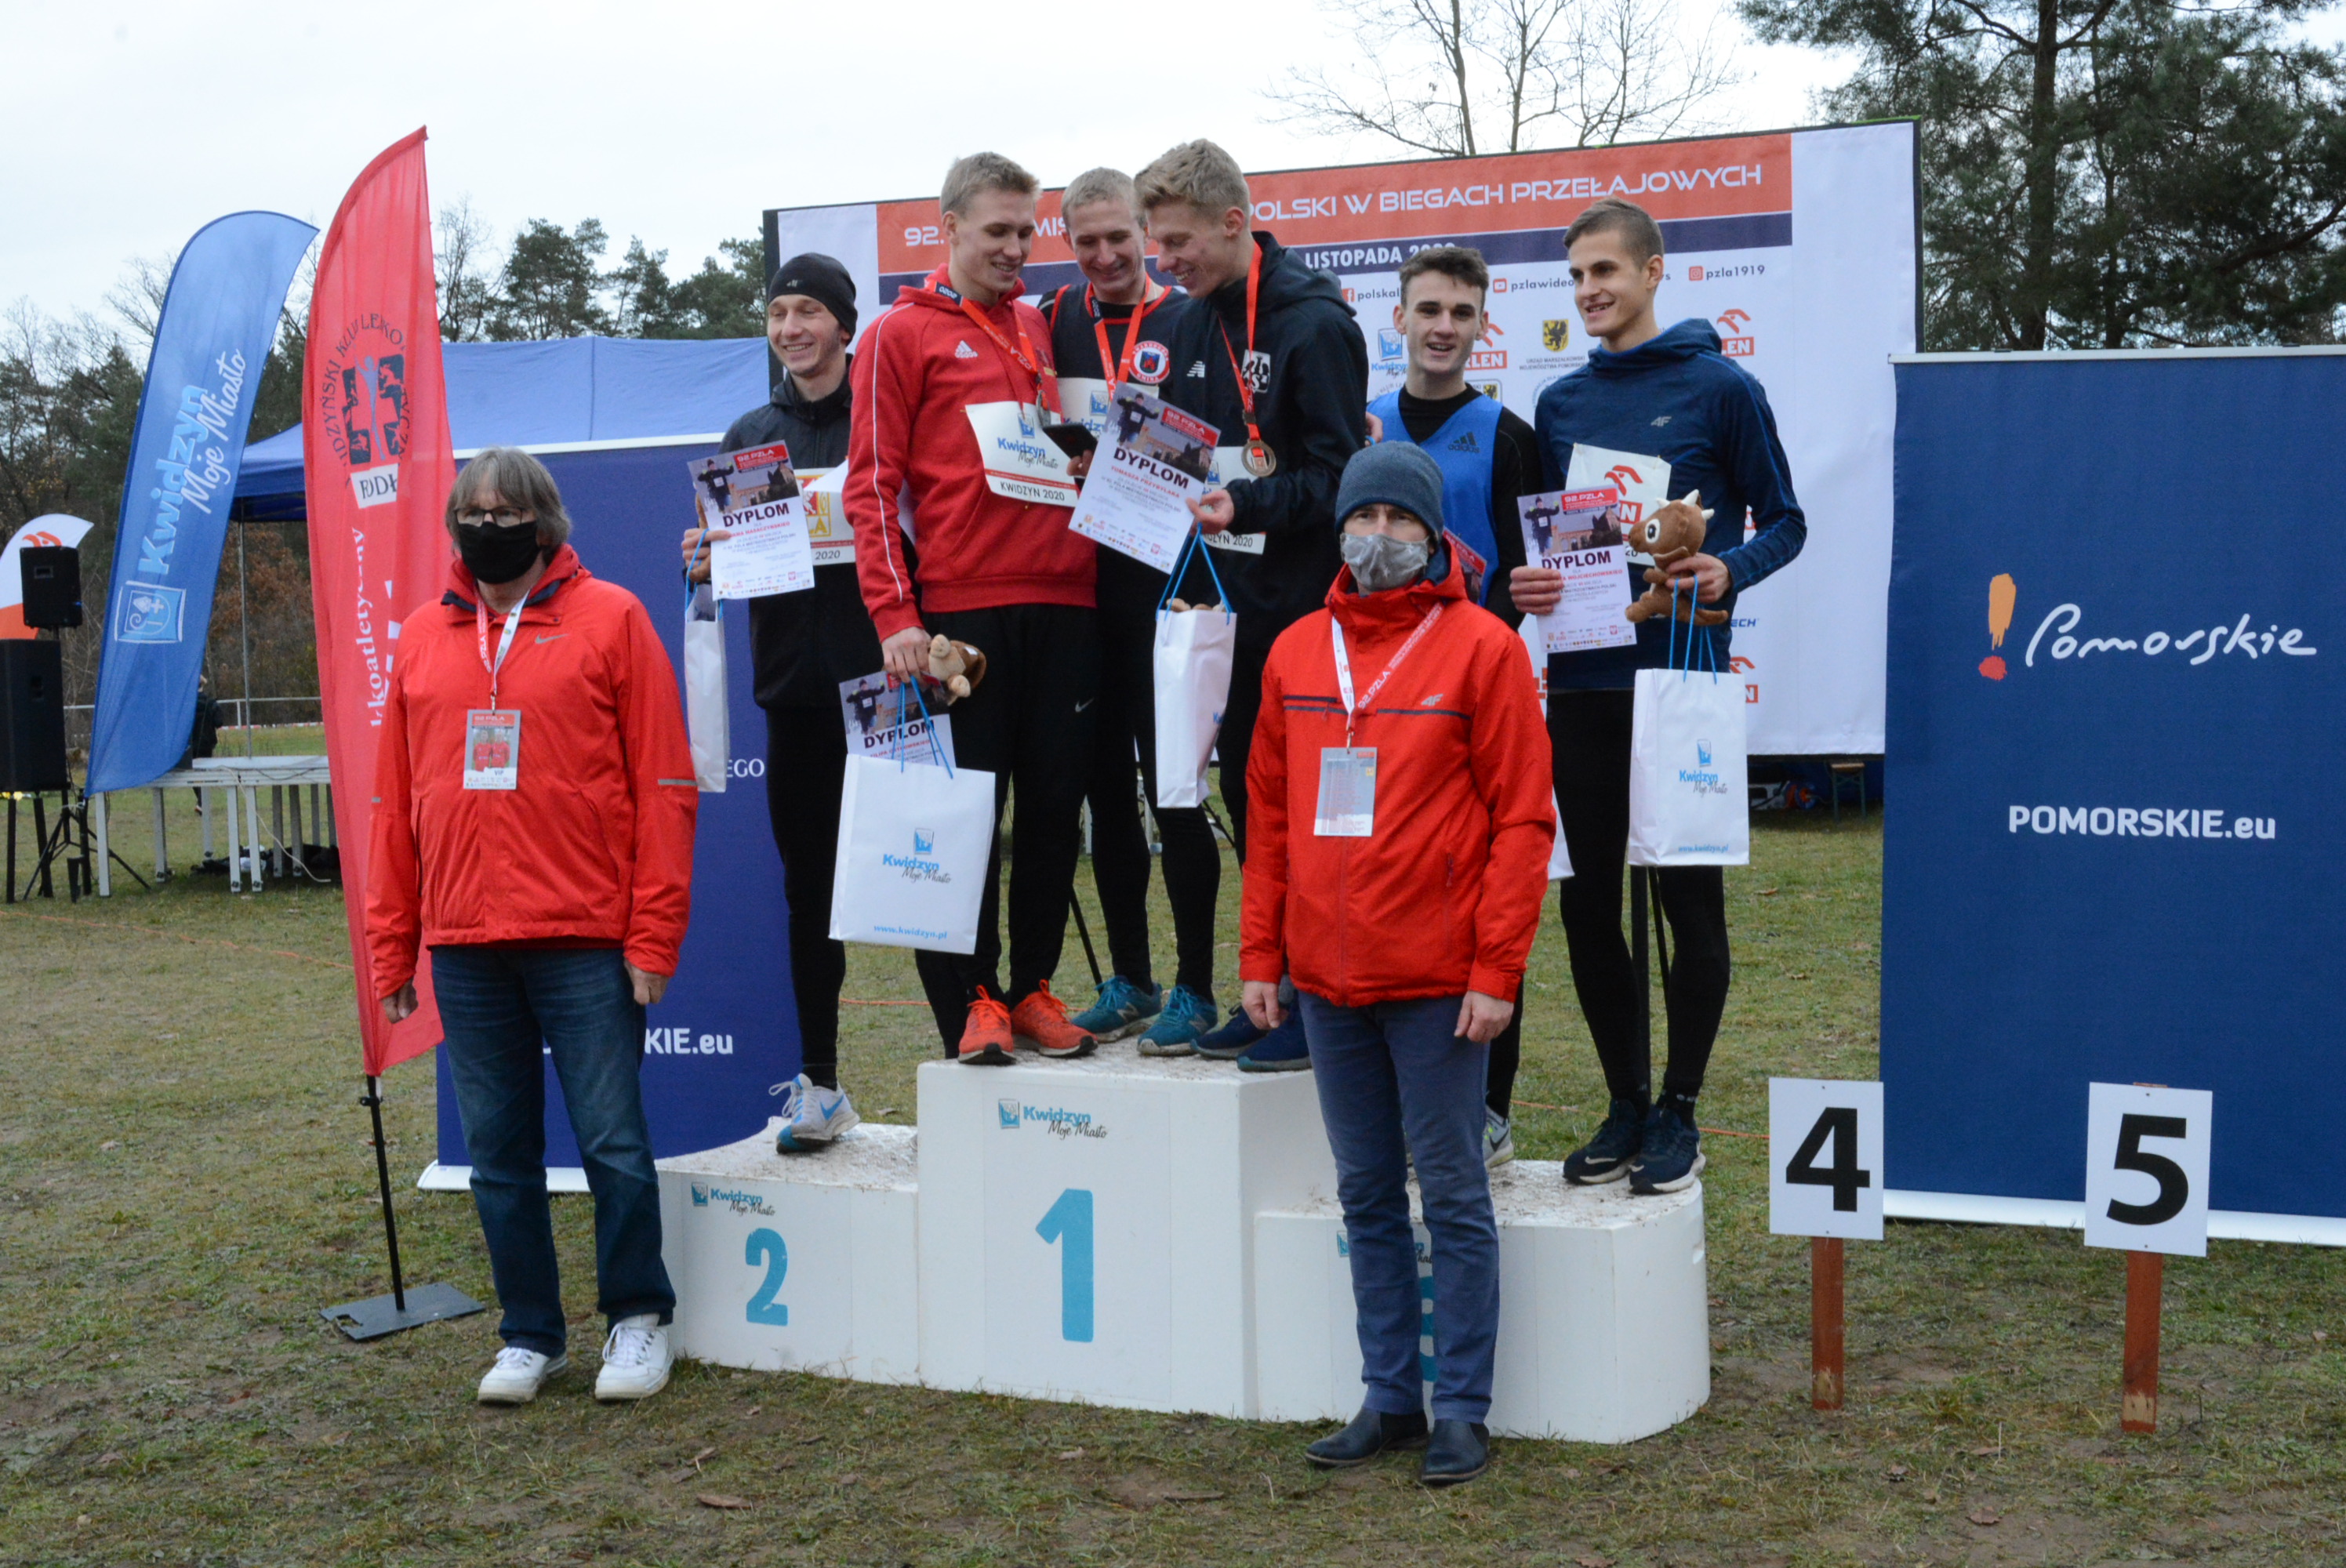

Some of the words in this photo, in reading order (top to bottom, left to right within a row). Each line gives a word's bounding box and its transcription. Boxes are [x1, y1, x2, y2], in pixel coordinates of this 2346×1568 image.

[904, 227, 944, 247] 92.
[1250, 196, 1337, 222] OLSKI
[1343, 193, 1372, 216] W
[1380, 184, 1503, 212] BIEGACH
[1511, 163, 1762, 203] PRZEŁAJOWYCH
[1305, 246, 1403, 270] LISTOPADA
[1511, 277, 1574, 292] pzlawideo
[1706, 264, 1765, 283] pzla1919
[1357, 287, 1400, 301] polskal
[197, 349, 246, 441] Miasto
[997, 437, 1046, 459] Kwidzyn
[1113, 446, 1189, 489] DYPLOM
[138, 384, 208, 575] Kwidzyn
[181, 445, 231, 514] Moje
[1000, 481, 1040, 498] KWIDZYN
[1043, 489, 1065, 501] 2020
[723, 503, 790, 528] DYPLOM
[1233, 535, 1253, 547] 2020
[815, 550, 841, 561] 2020
[1542, 550, 1611, 570] DYPLOM
[2025, 602, 2317, 668] Pomorskie
[863, 719, 935, 749] DYPLOM
[726, 758, 765, 778] EGO
[1679, 769, 1719, 786] Kwidzyn
[2009, 804, 2276, 840] POMORSKIE.eu
[882, 853, 940, 874] Kwidzyn
[902, 866, 923, 884] Moje
[924, 868, 951, 884] Miasto
[873, 923, 948, 941] www.kwidzyn.pl
[645, 1028, 734, 1055] KIE.eu
[1023, 1105, 1091, 1127] Kwidzyn
[1048, 1120, 1072, 1140] Moje
[1074, 1121, 1108, 1138] Miasto
[1785, 1106, 1871, 1212] 4
[2105, 1112, 2189, 1226] 5
[710, 1188, 763, 1206] Kwidzyn
[729, 1200, 749, 1217] Moje
[750, 1201, 776, 1217] Miasto
[1035, 1188, 1094, 1343] 1
[745, 1227, 789, 1327] 2
